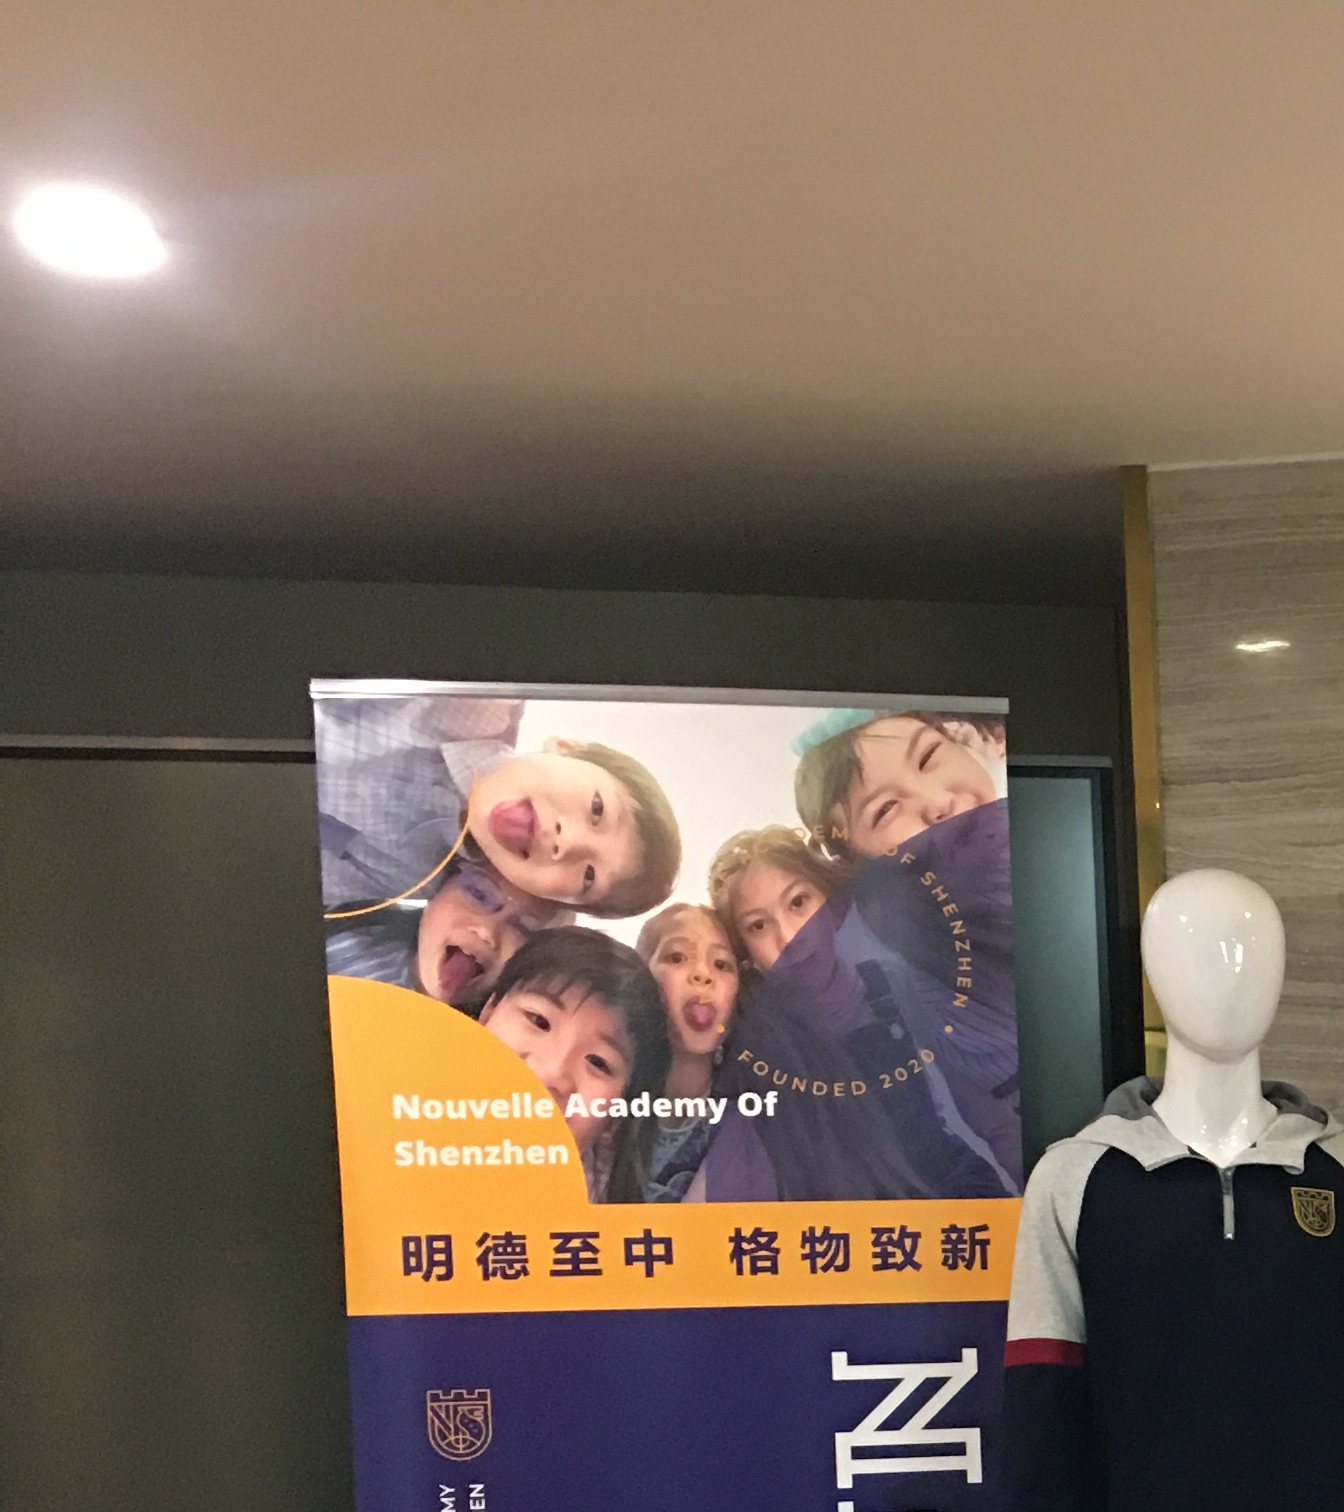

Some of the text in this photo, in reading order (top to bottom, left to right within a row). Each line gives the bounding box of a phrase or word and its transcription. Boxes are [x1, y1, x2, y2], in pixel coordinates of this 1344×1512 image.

[920, 870, 973, 1009] SHENZHEN
[737, 1049, 935, 1097] FOUNDED 2020
[392, 1091, 779, 1124] Nouvelle Academy Of
[394, 1139, 569, 1167] Shenzhen
[401, 1224, 991, 1282] 明德至中 格物致新
